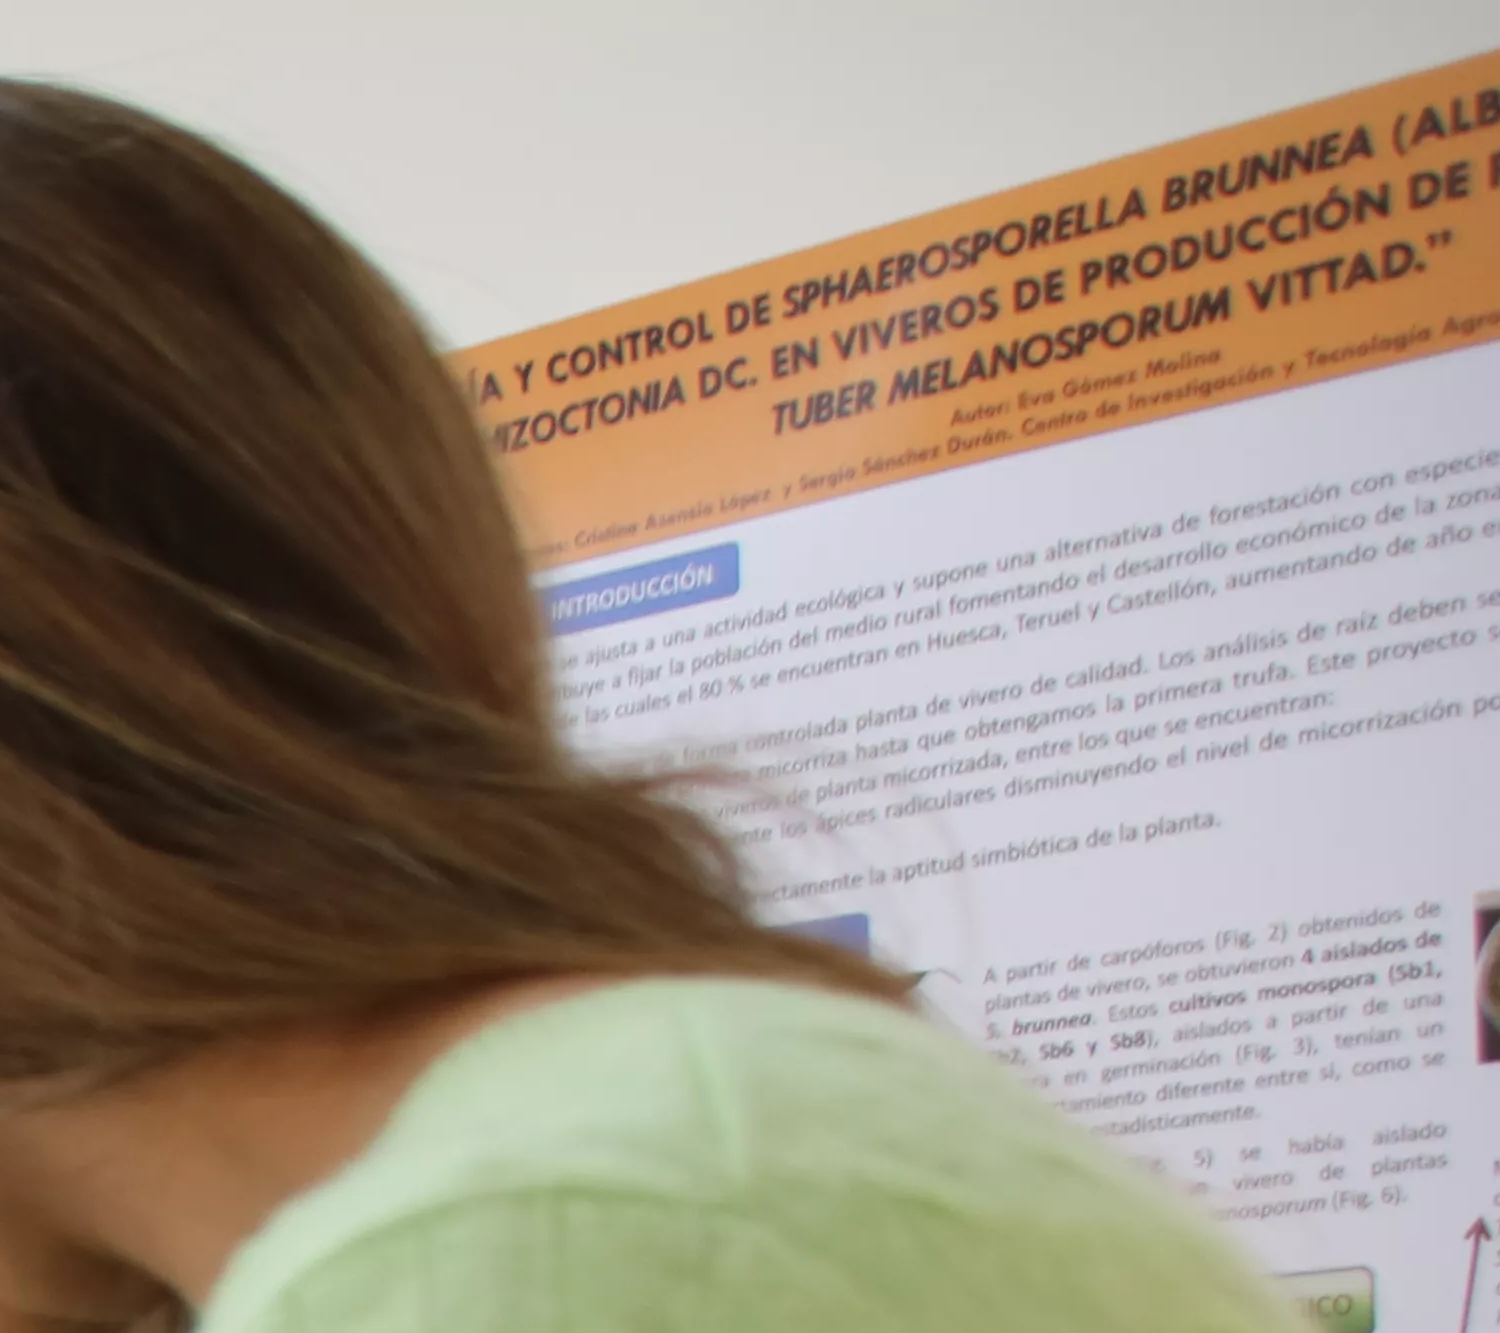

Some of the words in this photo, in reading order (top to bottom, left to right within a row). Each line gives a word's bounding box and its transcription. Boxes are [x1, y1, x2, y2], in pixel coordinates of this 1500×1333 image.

[514, 363, 534, 394] Y
[547, 311, 713, 384] CONTROL
[726, 294, 771, 333] DE
[783, 187, 1147, 317] SPHAEROSPORELLA
[1161, 122, 1375, 211] BRUNNEA
[700, 358, 757, 399] DC.
[771, 337, 819, 379] EN
[832, 287, 998, 362] VIVEROS
[1014, 269, 1066, 313] DE
[1080, 181, 1390, 295] PRODUCCIÓN
[1408, 162, 1469, 209] DE
[772, 376, 876, 434] TUBER
[888, 287, 1232, 402] MELANOSPORUM
[1017, 388, 1055, 410] Eva
[1062, 369, 1137, 400] Gómez
[1145, 346, 1222, 379] Molina
[645, 499, 713, 532] Asensio
[799, 462, 855, 493] Sergio
[862, 443, 940, 477] Sánchez
[947, 424, 1013, 455] Durán.
[1021, 407, 1088, 436] Centro
[1127, 359, 1273, 412] Investigación
[1305, 322, 1431, 368] Tecnología
[585, 638, 637, 669] ajusta
[662, 627, 695, 648] una
[703, 599, 787, 639] actividad
[794, 582, 885, 618] ecológica
[912, 562, 988, 592] supone
[996, 551, 1036, 574] una
[1044, 522, 1162, 563] alternativa
[1172, 511, 1200, 536] de
[1209, 481, 1340, 528] forestación
[1350, 474, 1395, 498] con
[585, 703, 609, 725] las
[615, 690, 671, 719] cuales
[777, 647, 888, 684] encuentran
[927, 623, 1008, 653] Huesca,
[1016, 598, 1081, 634] Teruel
[1106, 574, 1217, 615] Castellón,
[1225, 540, 1377, 590] aumentando
[1425, 520, 1473, 548] año
[627, 660, 662, 688] fijar
[669, 654, 684, 676] la
[691, 634, 782, 677] población
[789, 622, 818, 650] del
[825, 611, 887, 642] medio
[894, 596, 941, 628] rural
[949, 570, 1079, 616] fomentando
[1086, 561, 1106, 587] el
[1114, 538, 1227, 581] desarrollo
[1235, 512, 1366, 555] económico
[744, 712, 847, 751] controlada
[856, 702, 918, 735] planta
[957, 684, 1022, 710] vivero
[1064, 652, 1150, 689] calidad.
[1158, 649, 1195, 671] Los
[1203, 627, 1288, 662] análisis
[1387, 596, 1466, 626] deben
[758, 746, 847, 780] micorriza
[856, 736, 908, 762] hasta
[916, 728, 956, 756] que
[964, 702, 1096, 740] obtengamos
[1133, 678, 1223, 715] primera
[1233, 660, 1296, 690] trufa.
[1306, 651, 1356, 677] Este
[1366, 629, 1477, 671] proyecto
[815, 806, 876, 836] ápices
[884, 785, 995, 819] radiculares
[1004, 752, 1157, 797] disminuyendo
[1196, 733, 1249, 764] nivel
[1298, 698, 1461, 744] micorrización
[816, 773, 876, 806] planta
[884, 746, 1009, 787] micorrizada,
[1015, 737, 1072, 762] entre
[1079, 727, 1108, 750] los
[1116, 722, 1156, 748] que
[1195, 691, 1335, 730] encuentran:
[892, 849, 966, 885] aptitud
[972, 834, 1078, 869] simbiótica
[1144, 812, 1222, 844] planta.
[984, 991, 1051, 1019] plantas
[1087, 977, 1151, 998] vivero,
[1184, 954, 1295, 984] obtuvieron
[1320, 935, 1407, 963] aislados
[1006, 957, 1056, 987] partir
[1101, 940, 1205, 969] carpóforos
[1298, 908, 1403, 939] obtenidos
[1107, 1004, 1158, 1024] Estos
[1168, 990, 1246, 1016] cultivos
[1257, 972, 1375, 1002] monospora
[1101, 1048, 1220, 1086] germinación
[1172, 1016, 1252, 1043] aislados
[1291, 1000, 1349, 1031] partir
[1403, 993, 1443, 1011] una
[1156, 1077, 1245, 1103] diferente
[1255, 1070, 1309, 1090] entre
[1352, 1058, 1411, 1078] como
[1288, 1131, 1344, 1156] había
[1372, 1119, 1446, 1146] aislado
[1233, 1172, 1293, 1193] vivero
[1371, 1153, 1447, 1181] plantas
